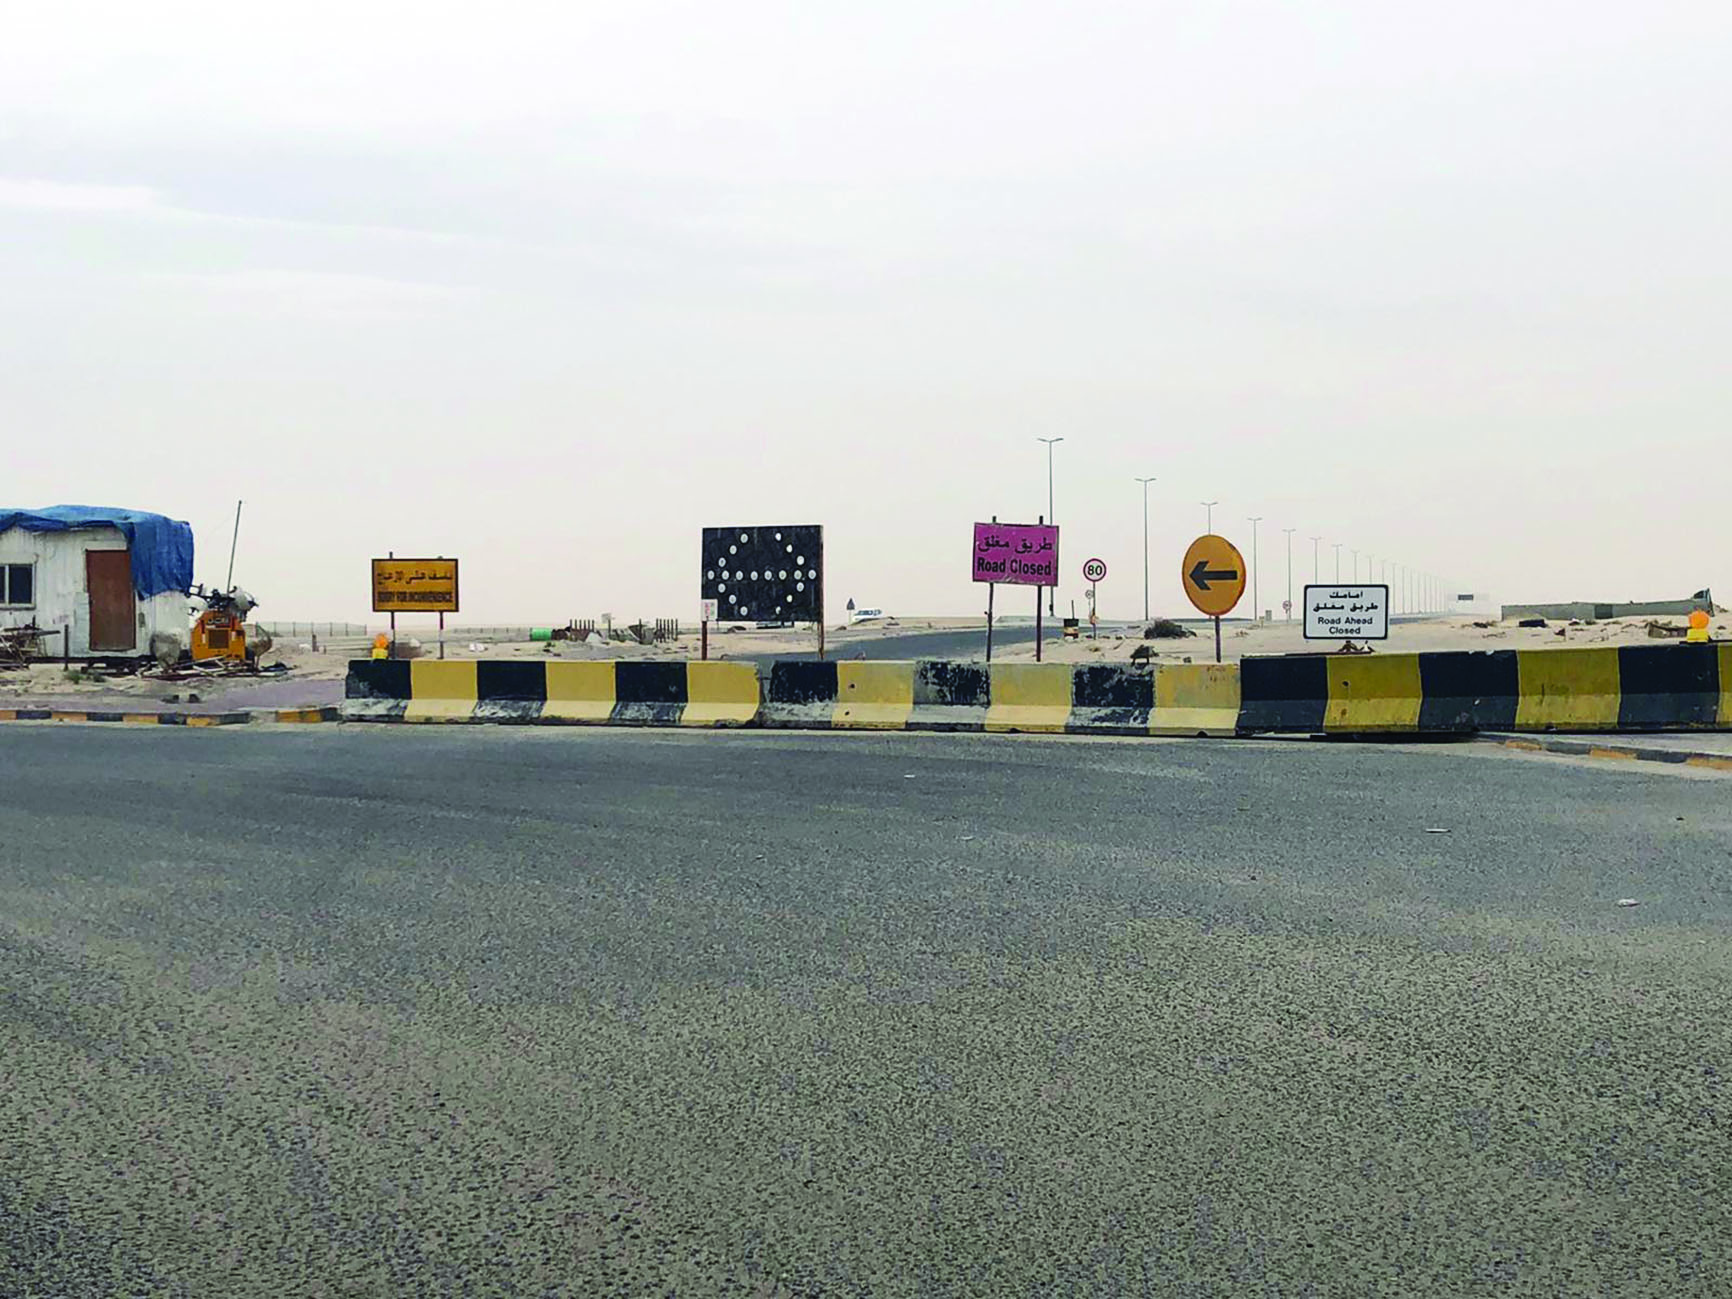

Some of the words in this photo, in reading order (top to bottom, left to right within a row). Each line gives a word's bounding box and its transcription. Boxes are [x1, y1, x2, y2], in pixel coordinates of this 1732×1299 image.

[978, 535, 1009, 552] مغلق
[1014, 537, 1052, 554] طريق
[977, 557, 1006, 573] Road
[1010, 559, 1052, 575] Closed
[1087, 565, 1103, 576] 80
[1313, 602, 1344, 612] مغلق
[1350, 602, 1378, 612] طريق
[1318, 616, 1341, 625] Road
[1344, 616, 1373, 625] Ahead
[1329, 626, 1361, 634] Closed
